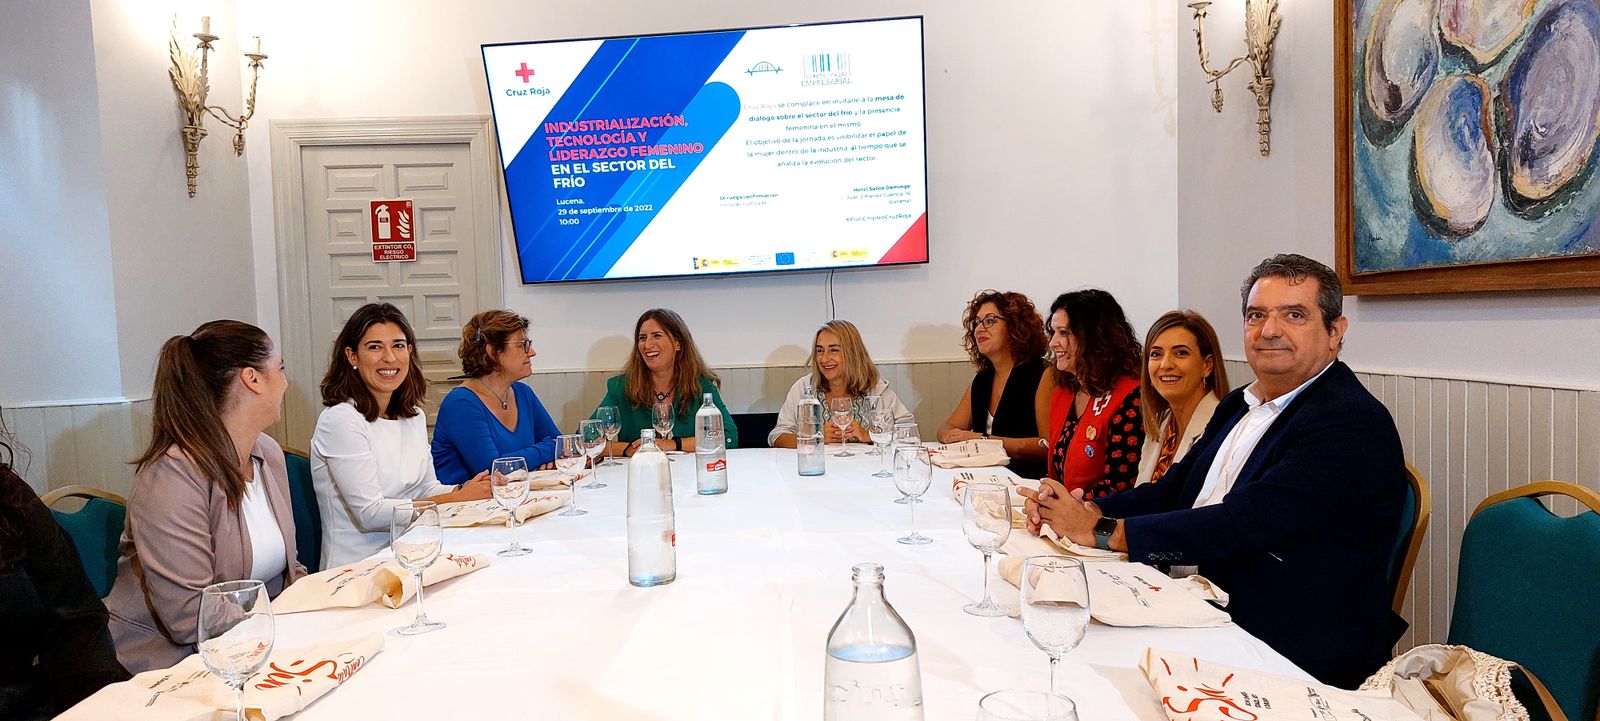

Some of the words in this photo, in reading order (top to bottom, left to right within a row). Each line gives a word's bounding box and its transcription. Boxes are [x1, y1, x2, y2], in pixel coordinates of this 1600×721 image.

[506, 88, 527, 97] Cruz
[530, 87, 551, 96] Roja
[787, 99, 820, 109] complace
[777, 112, 796, 121] sobre
[805, 111, 827, 119] sector
[867, 106, 901, 116] presencia
[544, 113, 688, 133] INDUSTRIALIZACIÓN,
[785, 123, 819, 132] femenina
[546, 131, 636, 148] TECNOLOGÍA
[637, 131, 648, 143] Y
[753, 137, 782, 148] objetivo
[799, 135, 826, 145] jornada
[877, 129, 896, 139] papel
[549, 146, 628, 162] LIDERAZGO
[630, 142, 704, 158] FEMENINO
[755, 150, 775, 159] mujer
[800, 147, 809, 155] de
[810, 146, 817, 154] la
[850, 143, 858, 151] al
[859, 142, 883, 152] tiempo
[884, 141, 898, 150] que
[843, 155, 855, 163] del
[551, 163, 571, 176] EN
[574, 163, 590, 174] EL
[592, 159, 647, 173] SECTOR
[649, 158, 676, 171] DEL
[553, 175, 586, 189] FRÍO
[556, 197, 585, 206] Lucena,
[558, 208, 567, 216] 29
[569, 207, 579, 216] de
[580, 205, 622, 216] septiembre
[624, 204, 633, 213] de
[634, 204, 653, 212] 2022
[559, 217, 580, 226] 10:00
